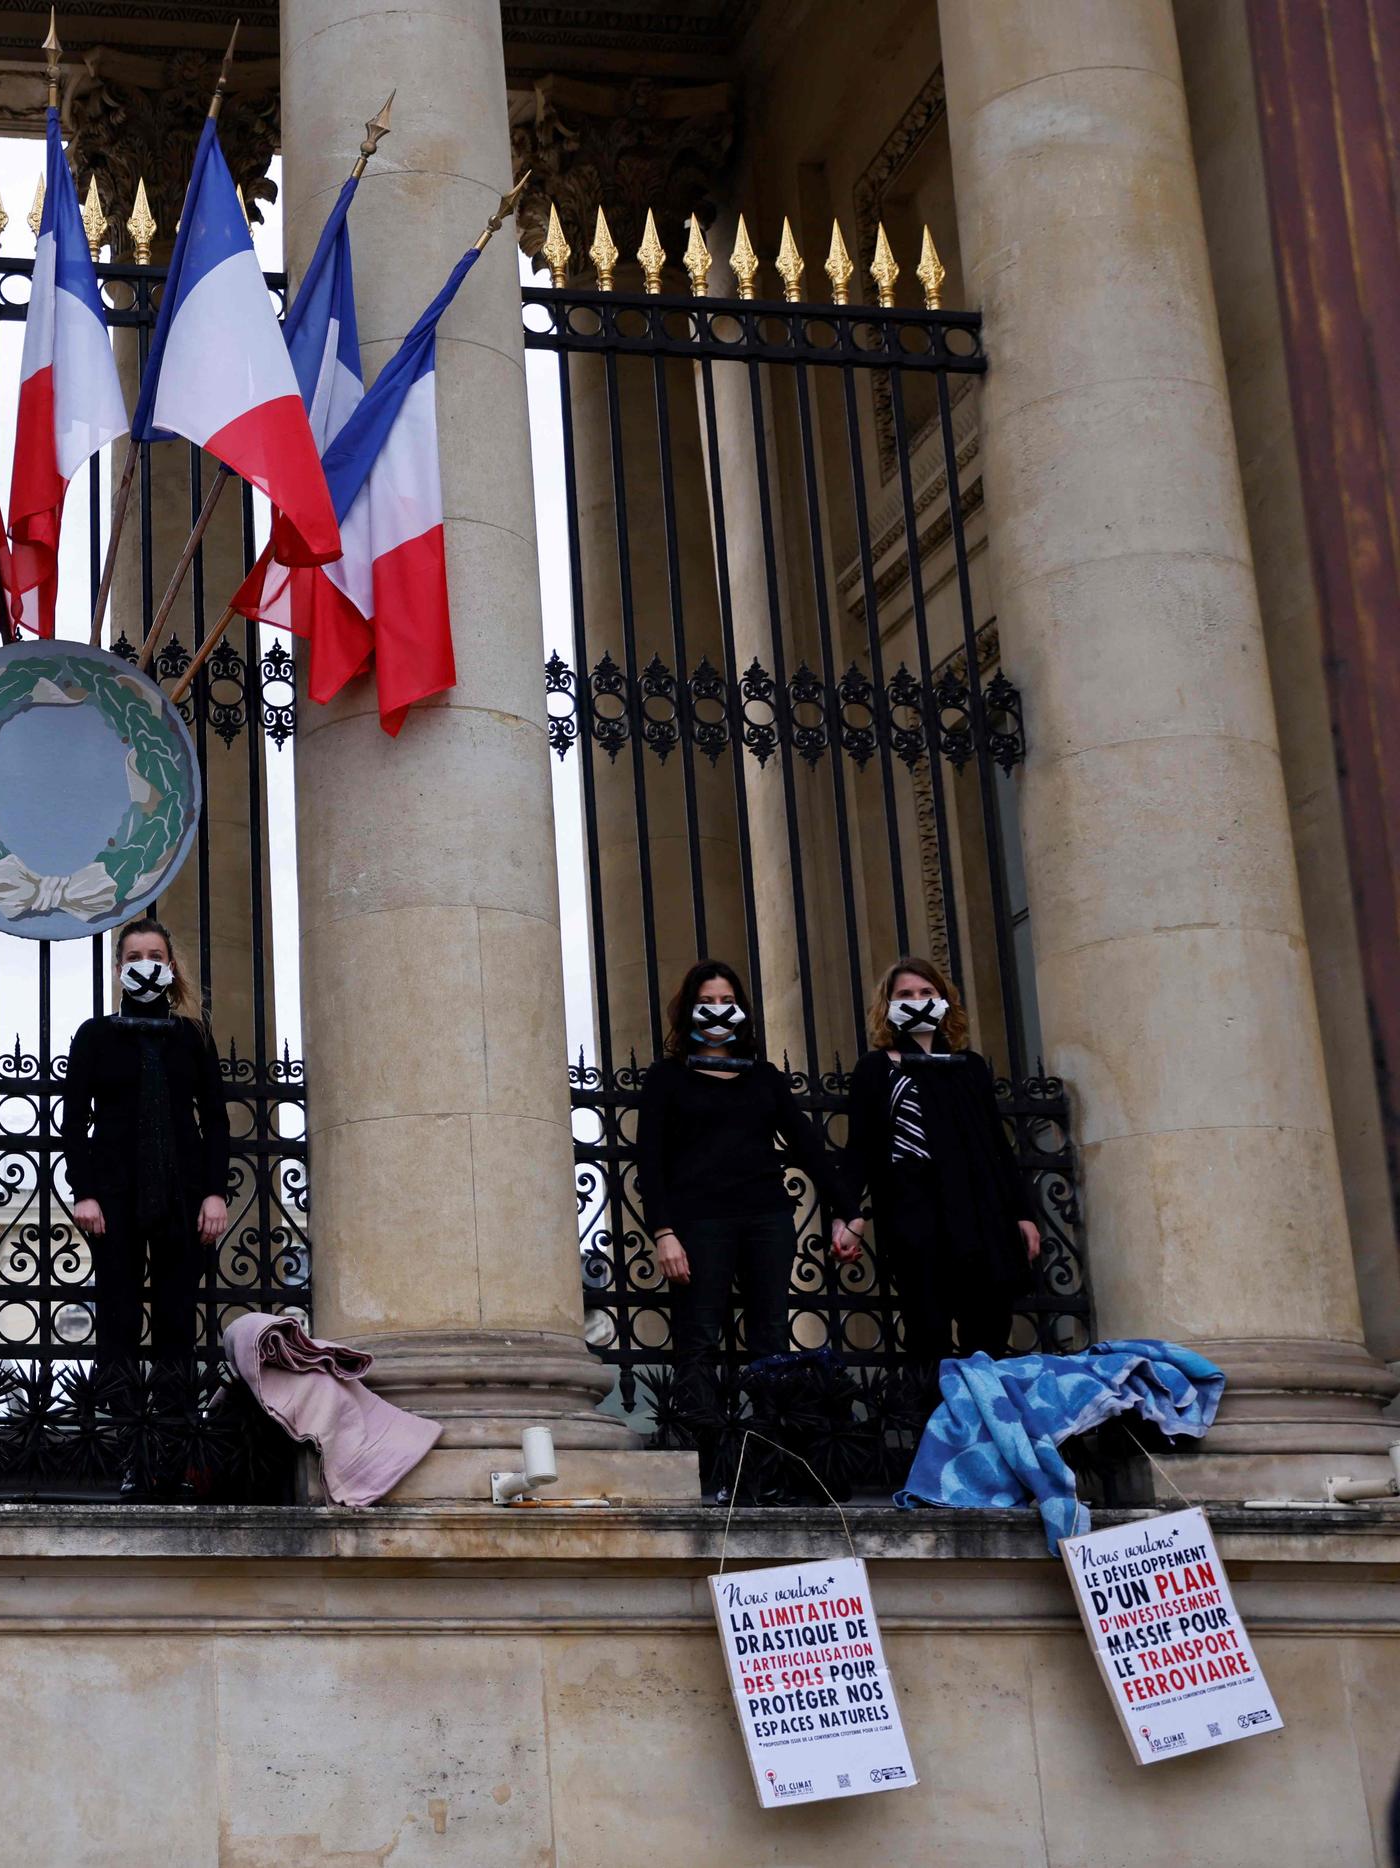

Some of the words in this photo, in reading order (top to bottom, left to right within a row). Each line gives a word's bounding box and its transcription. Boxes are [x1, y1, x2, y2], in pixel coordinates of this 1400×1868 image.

[1070, 1544, 1119, 1570] Nous
[1084, 1573, 1101, 1588] LE
[1103, 1545, 1208, 1584] DÉVELOPPEMENT
[723, 1583, 768, 1608] Nous
[1091, 1580, 1151, 1616] D'UN
[1154, 1562, 1217, 1599] PLAN
[730, 1612, 754, 1633] LA
[759, 1597, 864, 1629] LIMITATION
[1099, 1589, 1223, 1634] D'INVESTISSEMENT
[735, 1624, 839, 1655] DRASTIQUE
[846, 1619, 869, 1640] DE
[1106, 1621, 1172, 1656] MASSIF
[1179, 1607, 1232, 1637] POUR
[740, 1643, 874, 1674] L'ARTIFICIALISATION
[1114, 1657, 1135, 1679] LE
[1138, 1630, 1240, 1672] TRANSPORT
[744, 1676, 776, 1695] DES
[782, 1667, 824, 1691] SOLS
[829, 1660, 878, 1683] POUR
[1122, 1652, 1251, 1703] FERROVIAIRE
[748, 1688, 840, 1718] PROTÉGER
[846, 1681, 884, 1704] NOS
[754, 1717, 815, 1738] ESPACES
[819, 1705, 889, 1730] NATURELS
[1163, 1732, 1185, 1744] CLIMAT
[789, 1780, 812, 1790] CLIMAT
